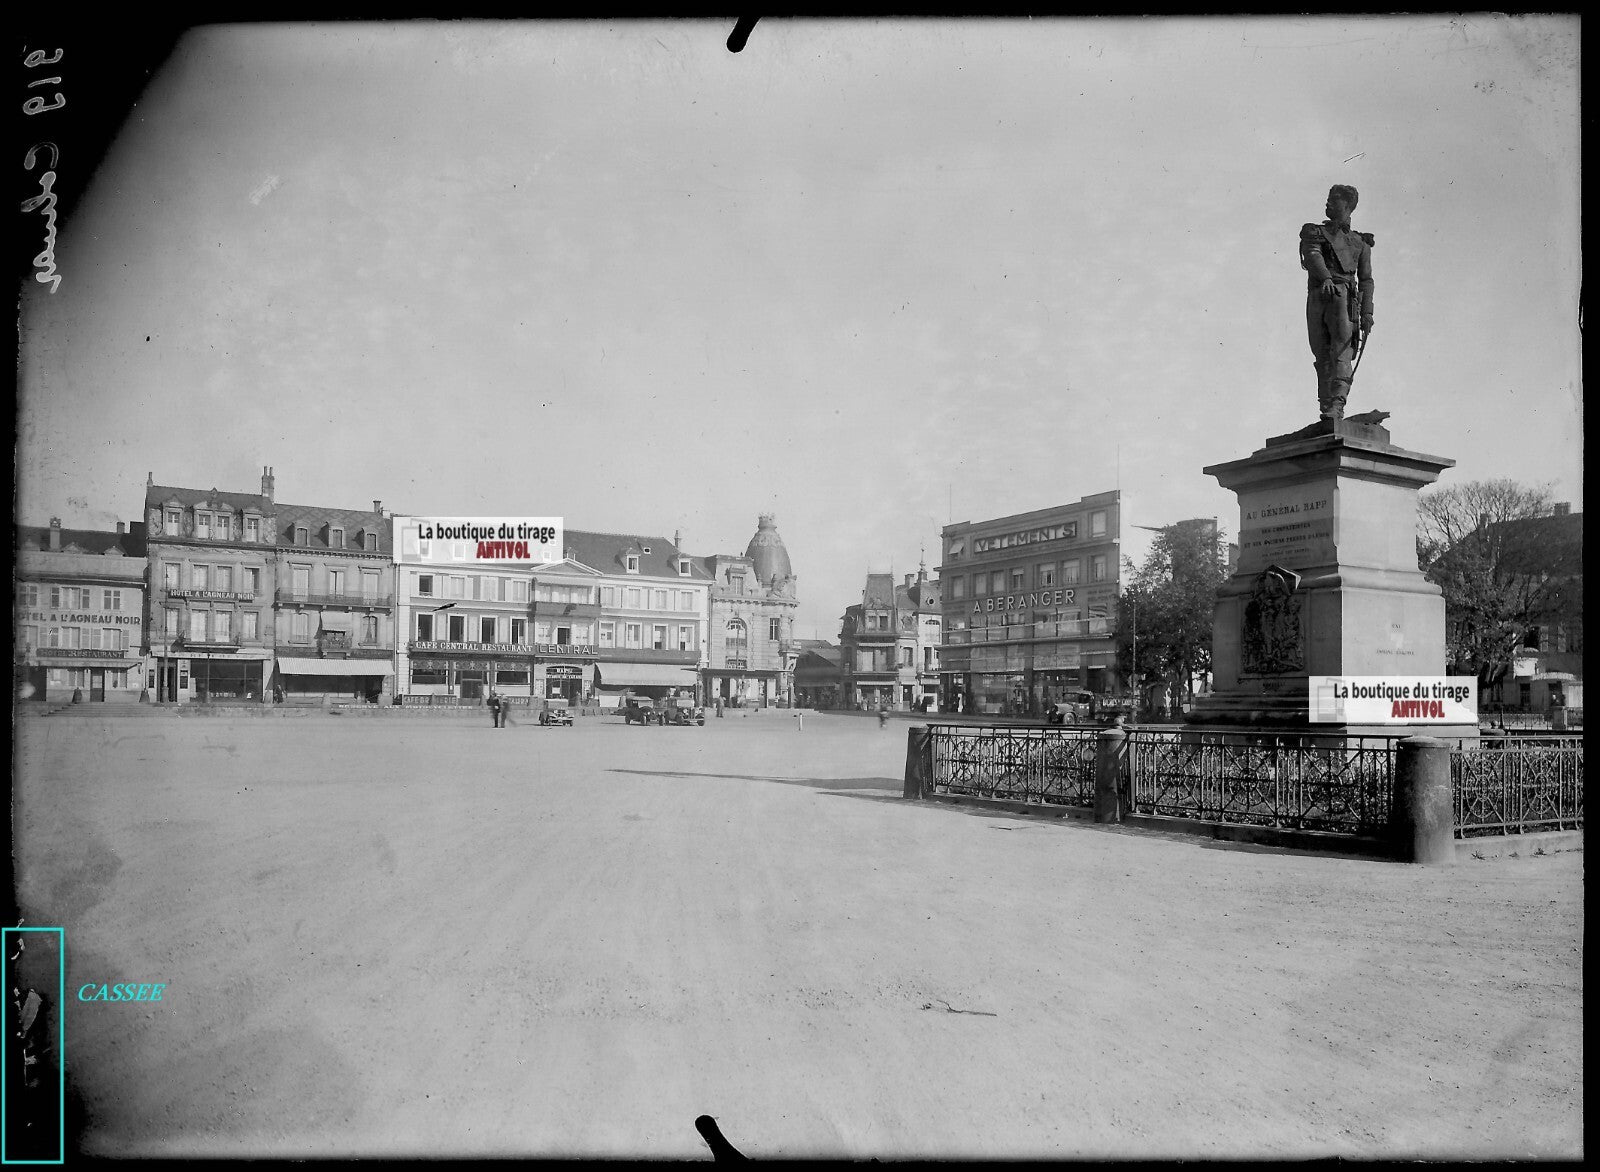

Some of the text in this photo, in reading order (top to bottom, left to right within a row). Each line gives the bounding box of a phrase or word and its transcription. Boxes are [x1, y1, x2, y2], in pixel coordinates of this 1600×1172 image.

[1246, 511, 1258, 520] AU
[1304, 500, 1327, 511] RAPP
[202, 591, 235, 599] L'AGNEAU
[973, 601, 983, 613] A
[987, 589, 1075, 612] BERANGER
[60, 614, 112, 624] L'AGNEAU
[115, 615, 141, 625] NOIR
[440, 642, 479, 651] CENTRAL
[481, 643, 533, 653] RESTAURANT
[539, 644, 598, 655] CENTRAL
